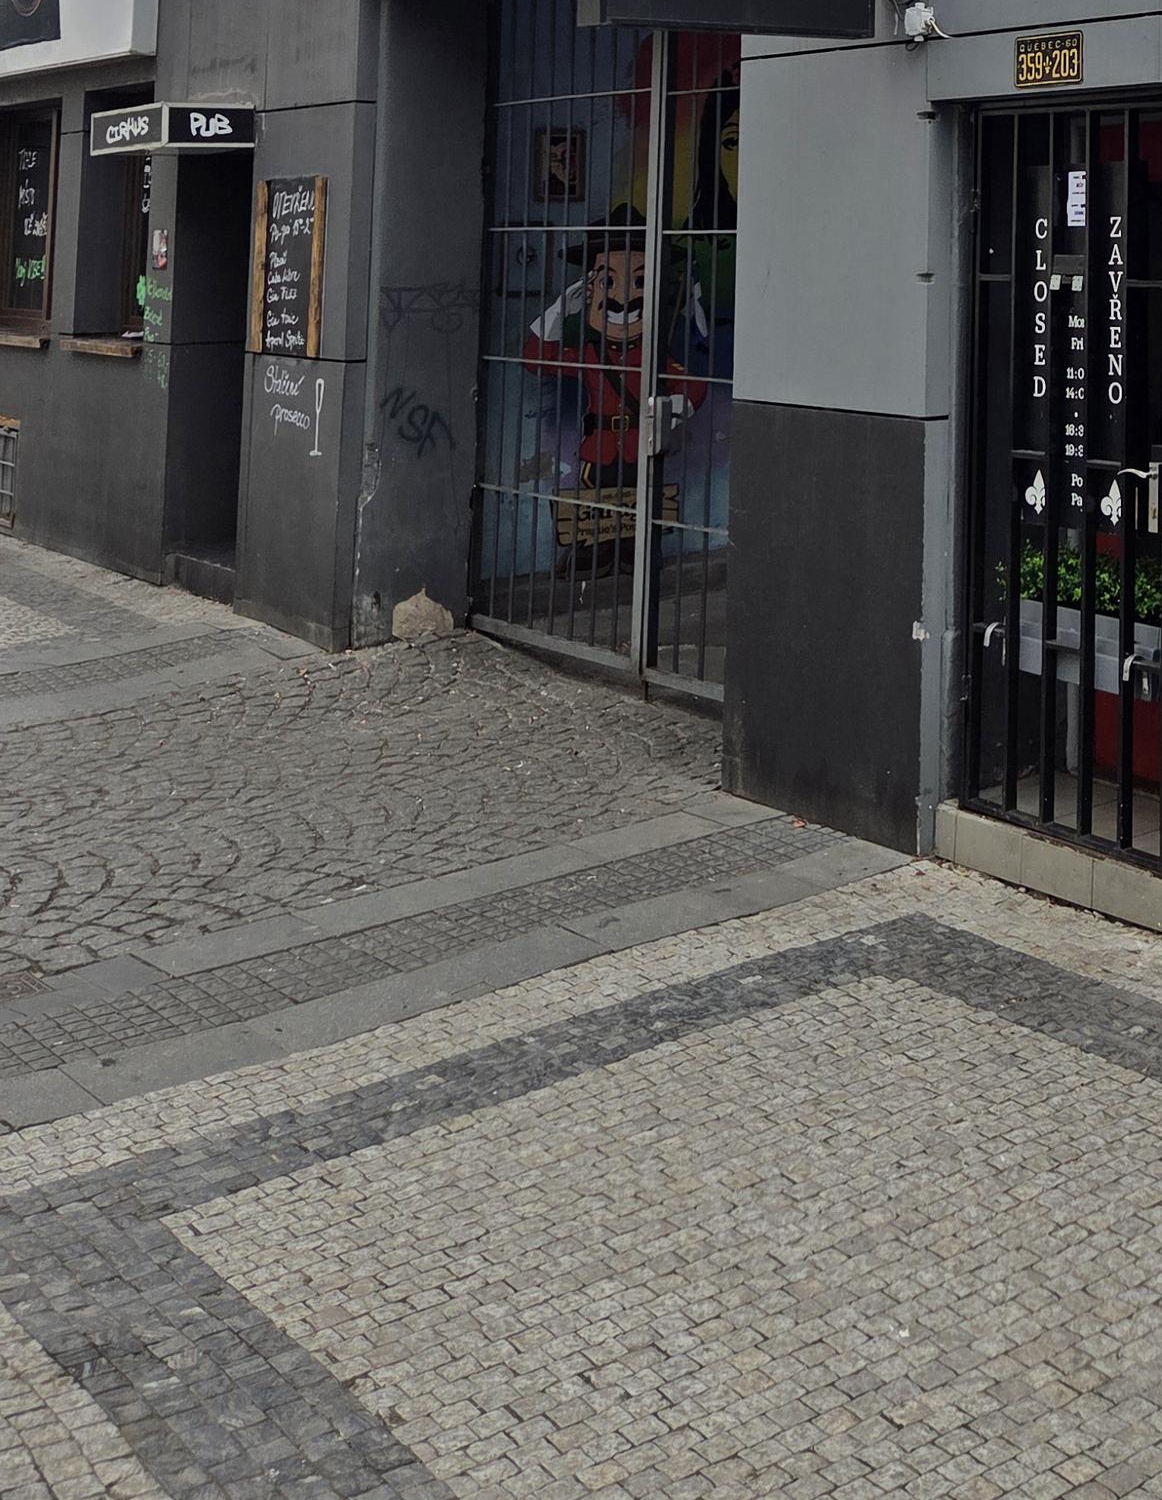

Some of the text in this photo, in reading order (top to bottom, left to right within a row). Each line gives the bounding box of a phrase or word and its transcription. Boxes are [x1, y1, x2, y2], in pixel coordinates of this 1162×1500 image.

[190, 112, 233, 137] PUB
[1033, 217, 1048, 398] CLOSED
[1108, 216, 1124, 405] ZAVŘENO
[1066, 367, 1085, 380] 11:0
